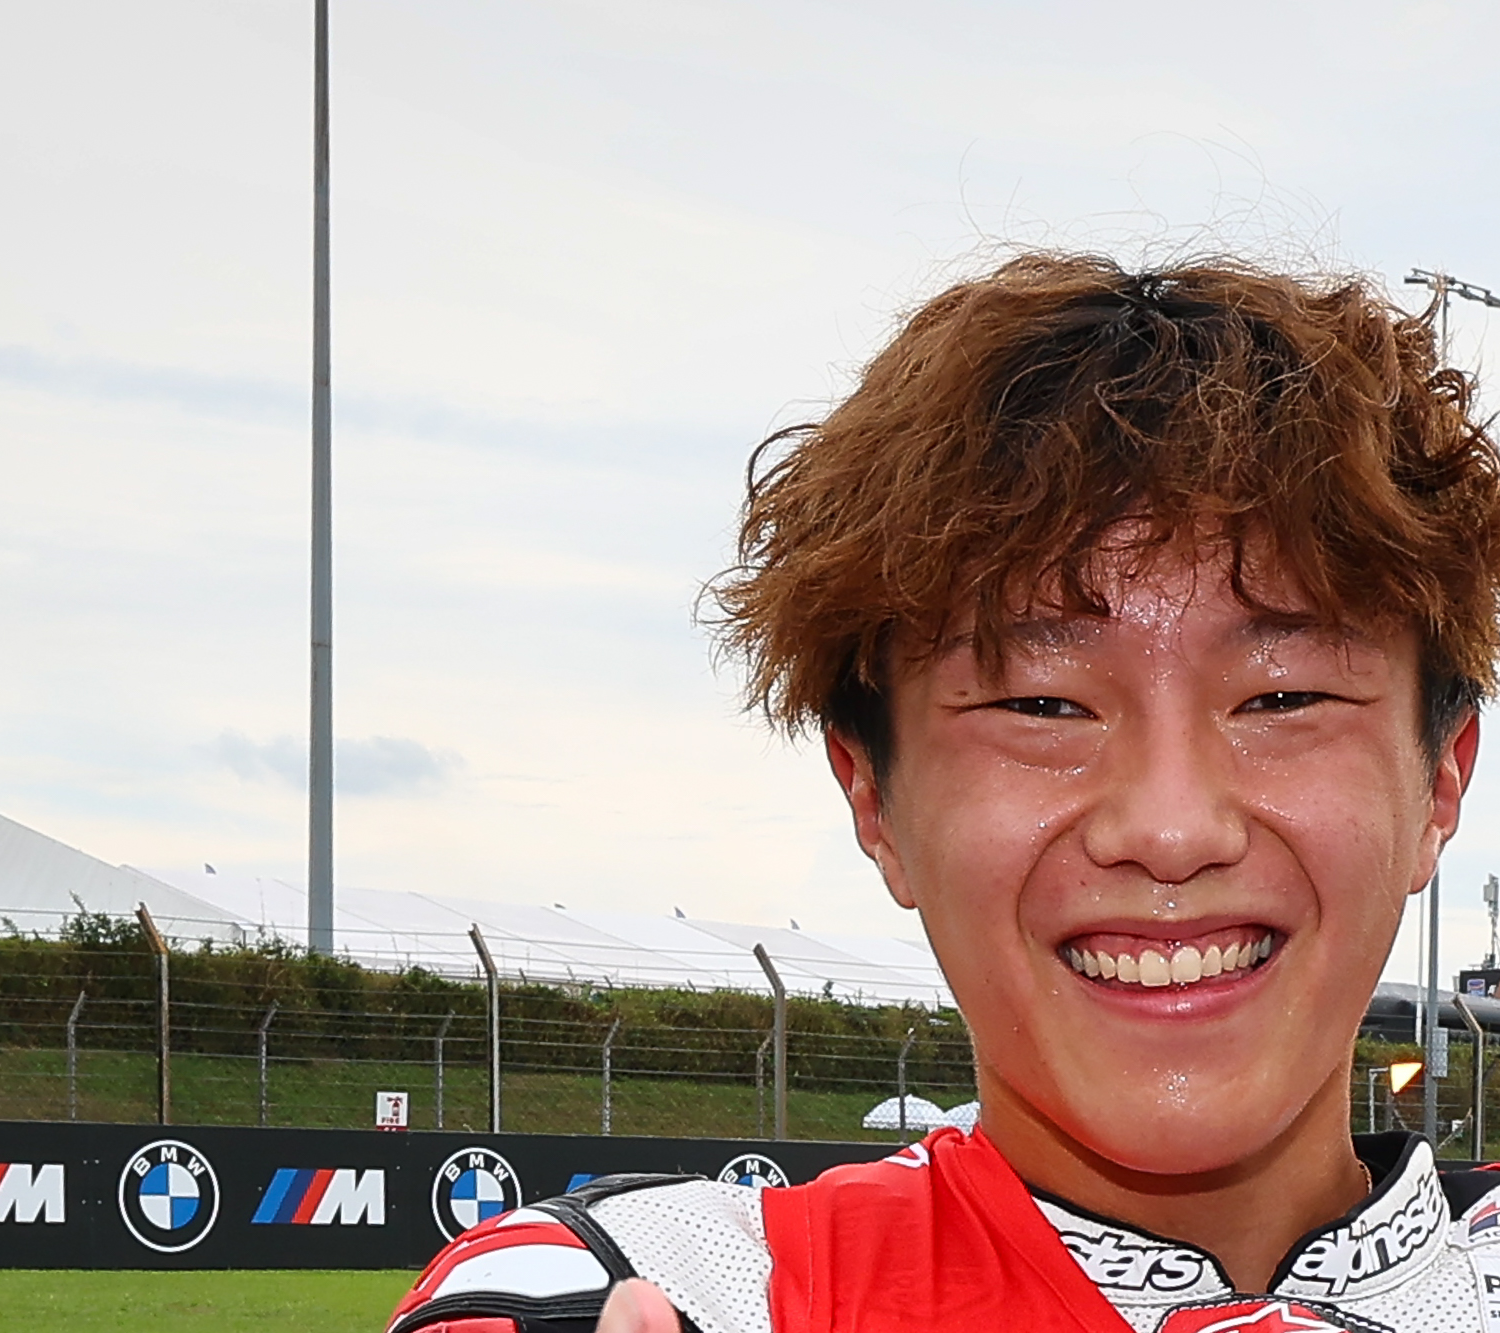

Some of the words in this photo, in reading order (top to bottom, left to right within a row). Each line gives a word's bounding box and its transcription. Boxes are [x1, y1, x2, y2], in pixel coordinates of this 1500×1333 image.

[133, 1147, 205, 1176] BMW
[445, 1154, 509, 1182] BMW
[725, 1161, 782, 1184] BMW
